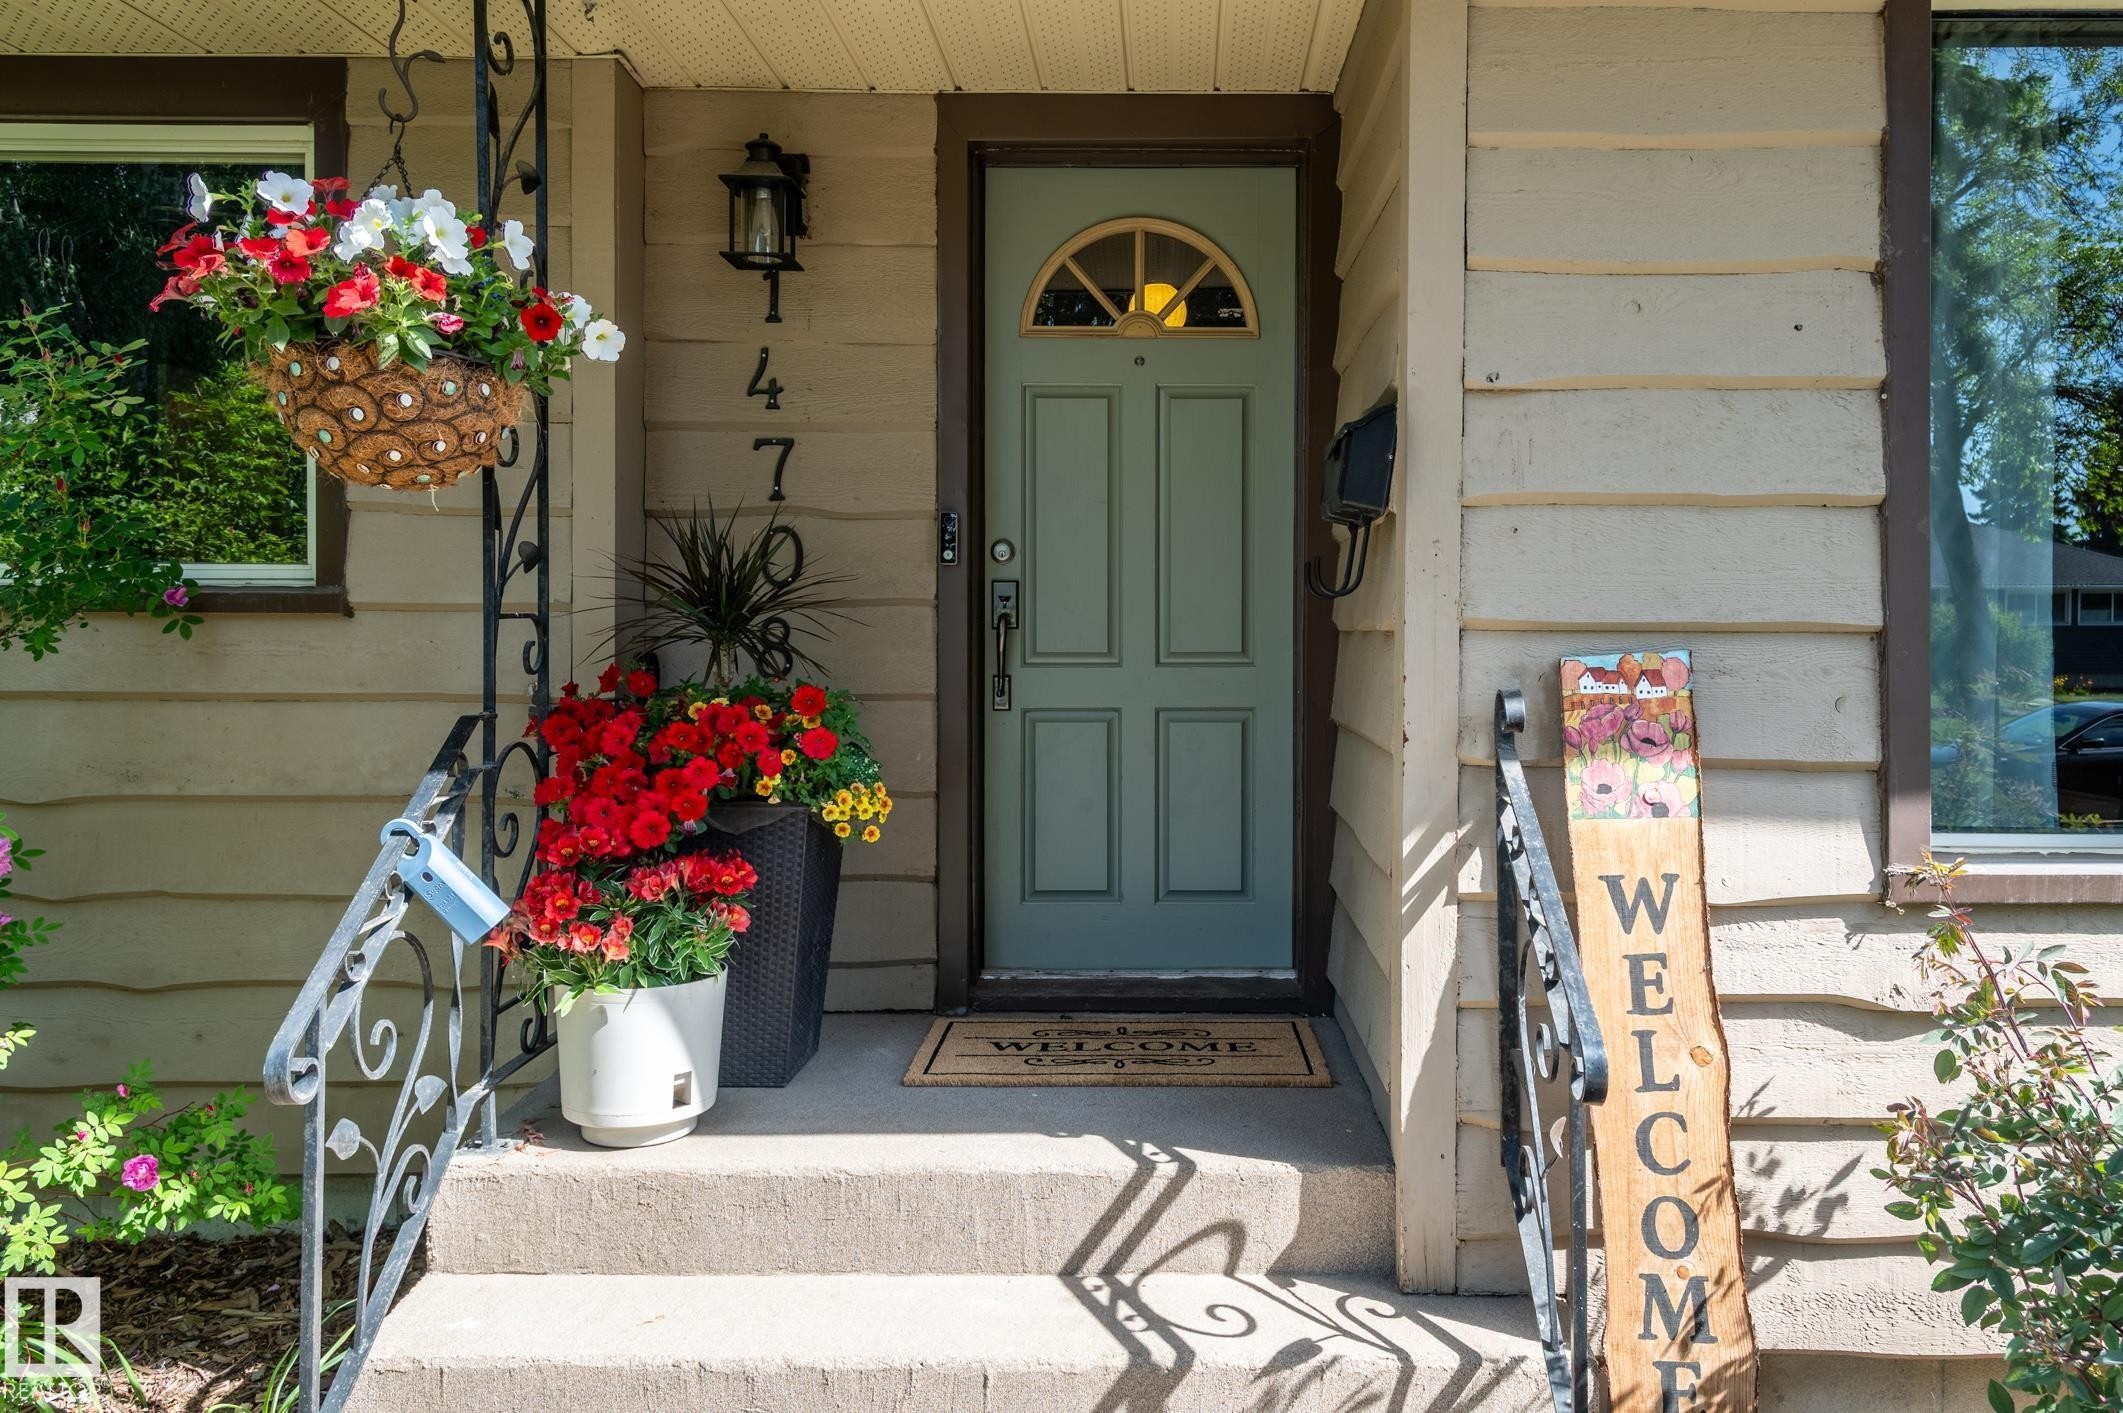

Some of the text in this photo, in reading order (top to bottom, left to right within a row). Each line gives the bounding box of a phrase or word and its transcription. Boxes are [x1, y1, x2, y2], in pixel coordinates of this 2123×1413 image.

[747, 269, 804, 679] 14708
[989, 1041, 1257, 1052] WELCOME
[1599, 873, 1718, 1413] WELCOME
